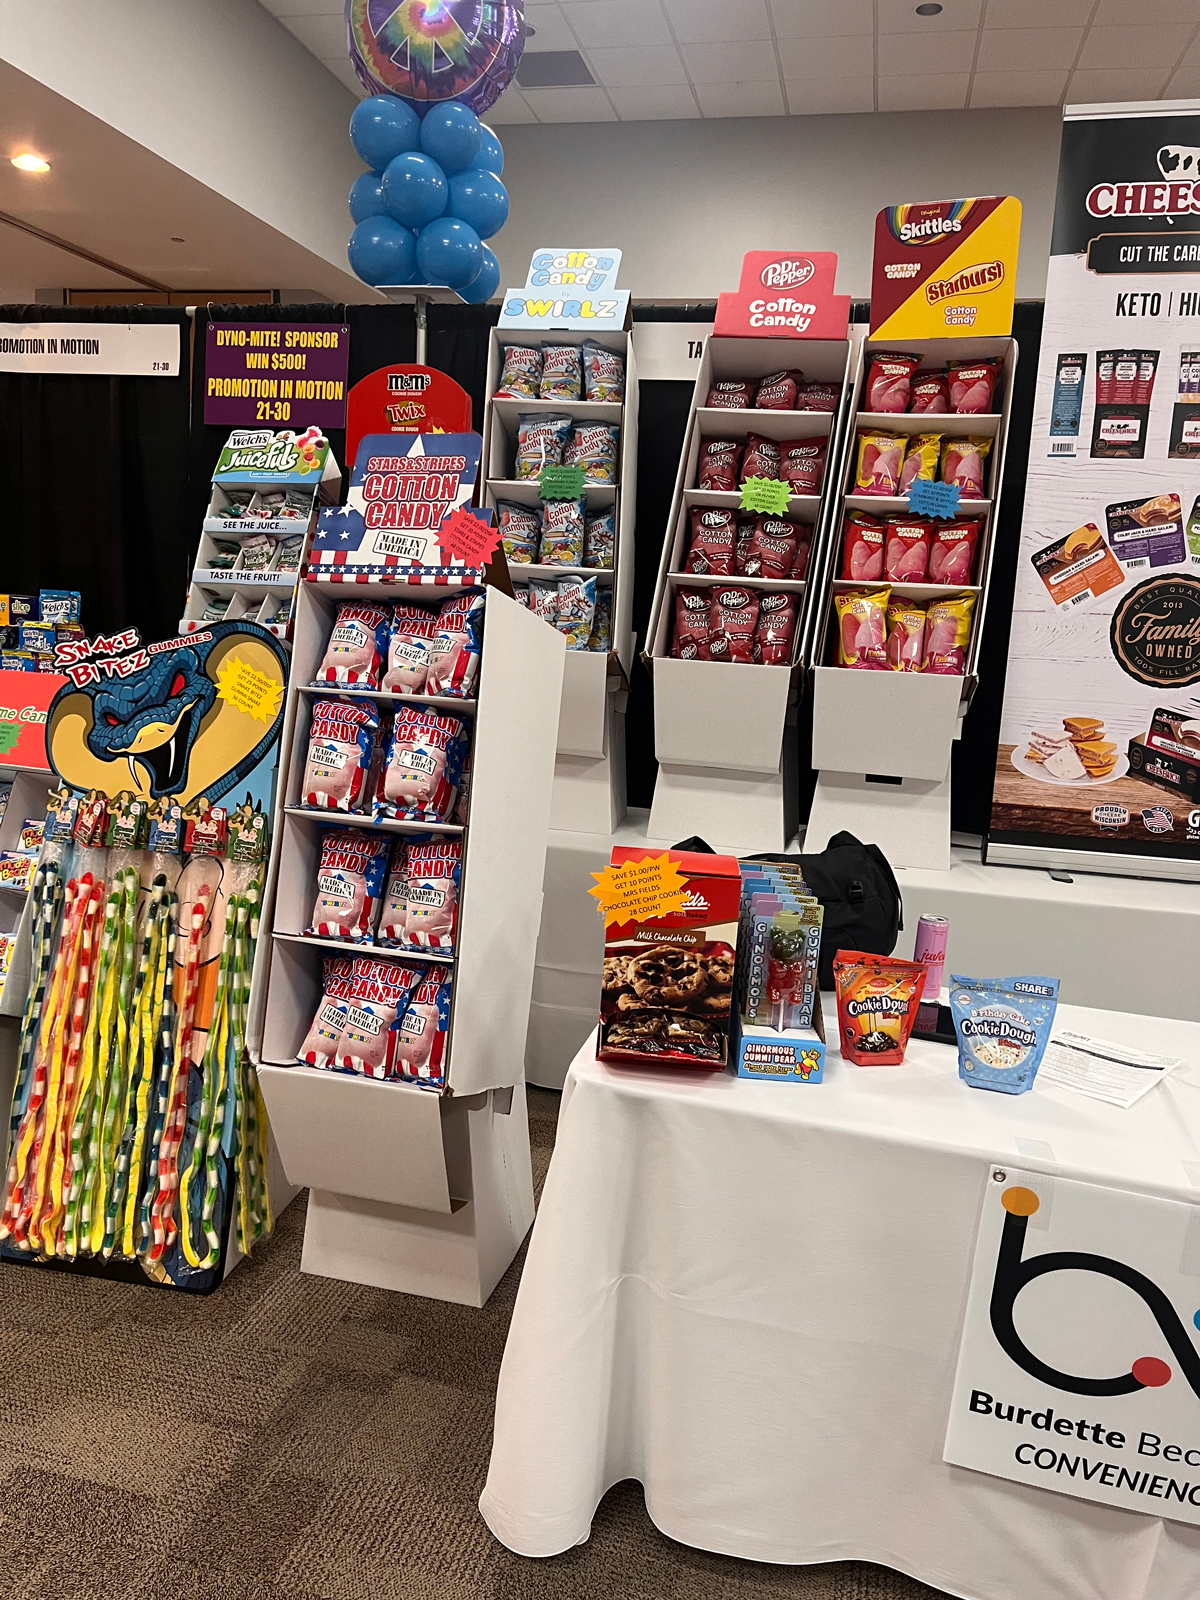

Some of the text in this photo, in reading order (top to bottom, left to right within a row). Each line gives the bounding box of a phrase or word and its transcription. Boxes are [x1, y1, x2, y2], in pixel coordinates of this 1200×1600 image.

[900, 217, 962, 241] Skittles
[532, 251, 614, 271] Cotton
[1119, 246, 1143, 263] CUT
[1147, 245, 1169, 262] THE
[766, 263, 811, 287] Pepper
[781, 260, 800, 275] Dr
[884, 262, 921, 273] COTTON
[886, 270, 918, 280] CANDY
[531, 269, 607, 292] Candy
[926, 261, 1003, 302] Starburst
[504, 298, 618, 319] SWIRLZ
[750, 298, 817, 316] Cotton
[944, 306, 977, 316] Cotton
[1115, 293, 1162, 317] KETO
[750, 313, 812, 332] Candy
[944, 315, 976, 327] Candy
[47, 339, 58, 354] IN
[60, 339, 100, 355] MOTION
[216, 330, 339, 348] DYNO-MITE! SPONSOR
[687, 340, 702, 359] TA
[152, 362, 170, 371] 21-30
[245, 352, 306, 370] WIN $500!
[207, 377, 344, 400] PROMOTION IN MOTION
[256, 400, 291, 421] 21-30
[232, 434, 268, 447] Welch's
[219, 440, 299, 472] Juicefuls
[364, 473, 460, 500] COTTON
[366, 501, 450, 529] CANDY
[223, 521, 288, 530] SEE THE JUICE...
[453, 526, 466, 538] STARS
[459, 522, 468, 530] GET
[473, 530, 488, 543] POINTS
[699, 529, 733, 538] COTTON
[896, 527, 925, 536] COTTON
[938, 529, 968, 537] COTTON
[380, 534, 423, 550] MADE IN
[702, 536, 731, 545] CANDY
[758, 536, 790, 550] COTTON
[897, 531, 923, 540] CANDY
[939, 533, 966, 541] CANDY
[376, 541, 420, 557] AMERICA
[449, 533, 480, 556] COTTON CANDY
[455, 546, 471, 558] COUNT
[759, 542, 786, 556] CANDY
[209, 571, 280, 582] TASTE THE FRUIT!
[719, 592, 748, 606] Pepper
[730, 590, 742, 599] Dr
[1134, 589, 1160, 610] BEST
[11, 600, 31, 612] slice
[1162, 601, 1183, 609] 2013
[336, 607, 384, 630] CANDY
[718, 609, 752, 620] COTTON
[722, 615, 749, 626] CANDY
[54, 629, 138, 666] SNAKE
[148, 631, 213, 654] GUMMIES
[1145, 643, 1193, 659] OWNED
[67, 651, 151, 688] BITEZ
[1158, 668, 1180, 676] FILL
[236, 681, 251, 692] SNAKE
[237, 673, 247, 682] GET
[252, 682, 268, 695] POINTS
[237, 698, 254, 710] COUNT
[247, 695, 262, 707] SNAKE
[313, 701, 370, 724] COTTON
[397, 707, 461, 736] COTTON
[310, 719, 360, 745] CANDY
[314, 746, 336, 758] MADE
[1095, 807, 1128, 815] PROUDLY
[1094, 815, 1127, 824] WISCONSIN
[321, 835, 381, 857] COTTON
[407, 841, 462, 859] COTTON
[320, 850, 370, 875] CANDY
[406, 860, 457, 879] CANDY
[611, 865, 661, 881] SAVE $1.00/PW
[614, 874, 662, 890] GET 10 POINTS
[411, 888, 433, 898] MADE
[623, 884, 661, 898] MRS FIELDS
[603, 897, 641, 912] CHOCOLATE
[642, 894, 658, 903] CHIP
[658, 889, 684, 900] COOKIE
[638, 903, 662, 914] COUNT
[636, 931, 698, 944] Milk Chocolate Chip
[353, 957, 414, 989] COTTON
[749, 921, 768, 1019] GINORMOUS
[350, 977, 404, 1008] CANDY
[1014, 982, 1049, 996] SHARE
[848, 996, 882, 1016] Cookie
[349, 1014, 379, 1033] AMERICA
[351, 1007, 380, 1026] MADE IN
[970, 1009, 1031, 1027] Birthday Cake
[961, 1020, 1038, 1046] Cookie Dough
[746, 1044, 796, 1056] GINORMOUS
[743, 1052, 797, 1065] GUMMI BEAR
[968, 1388, 1127, 1450] Burdette
